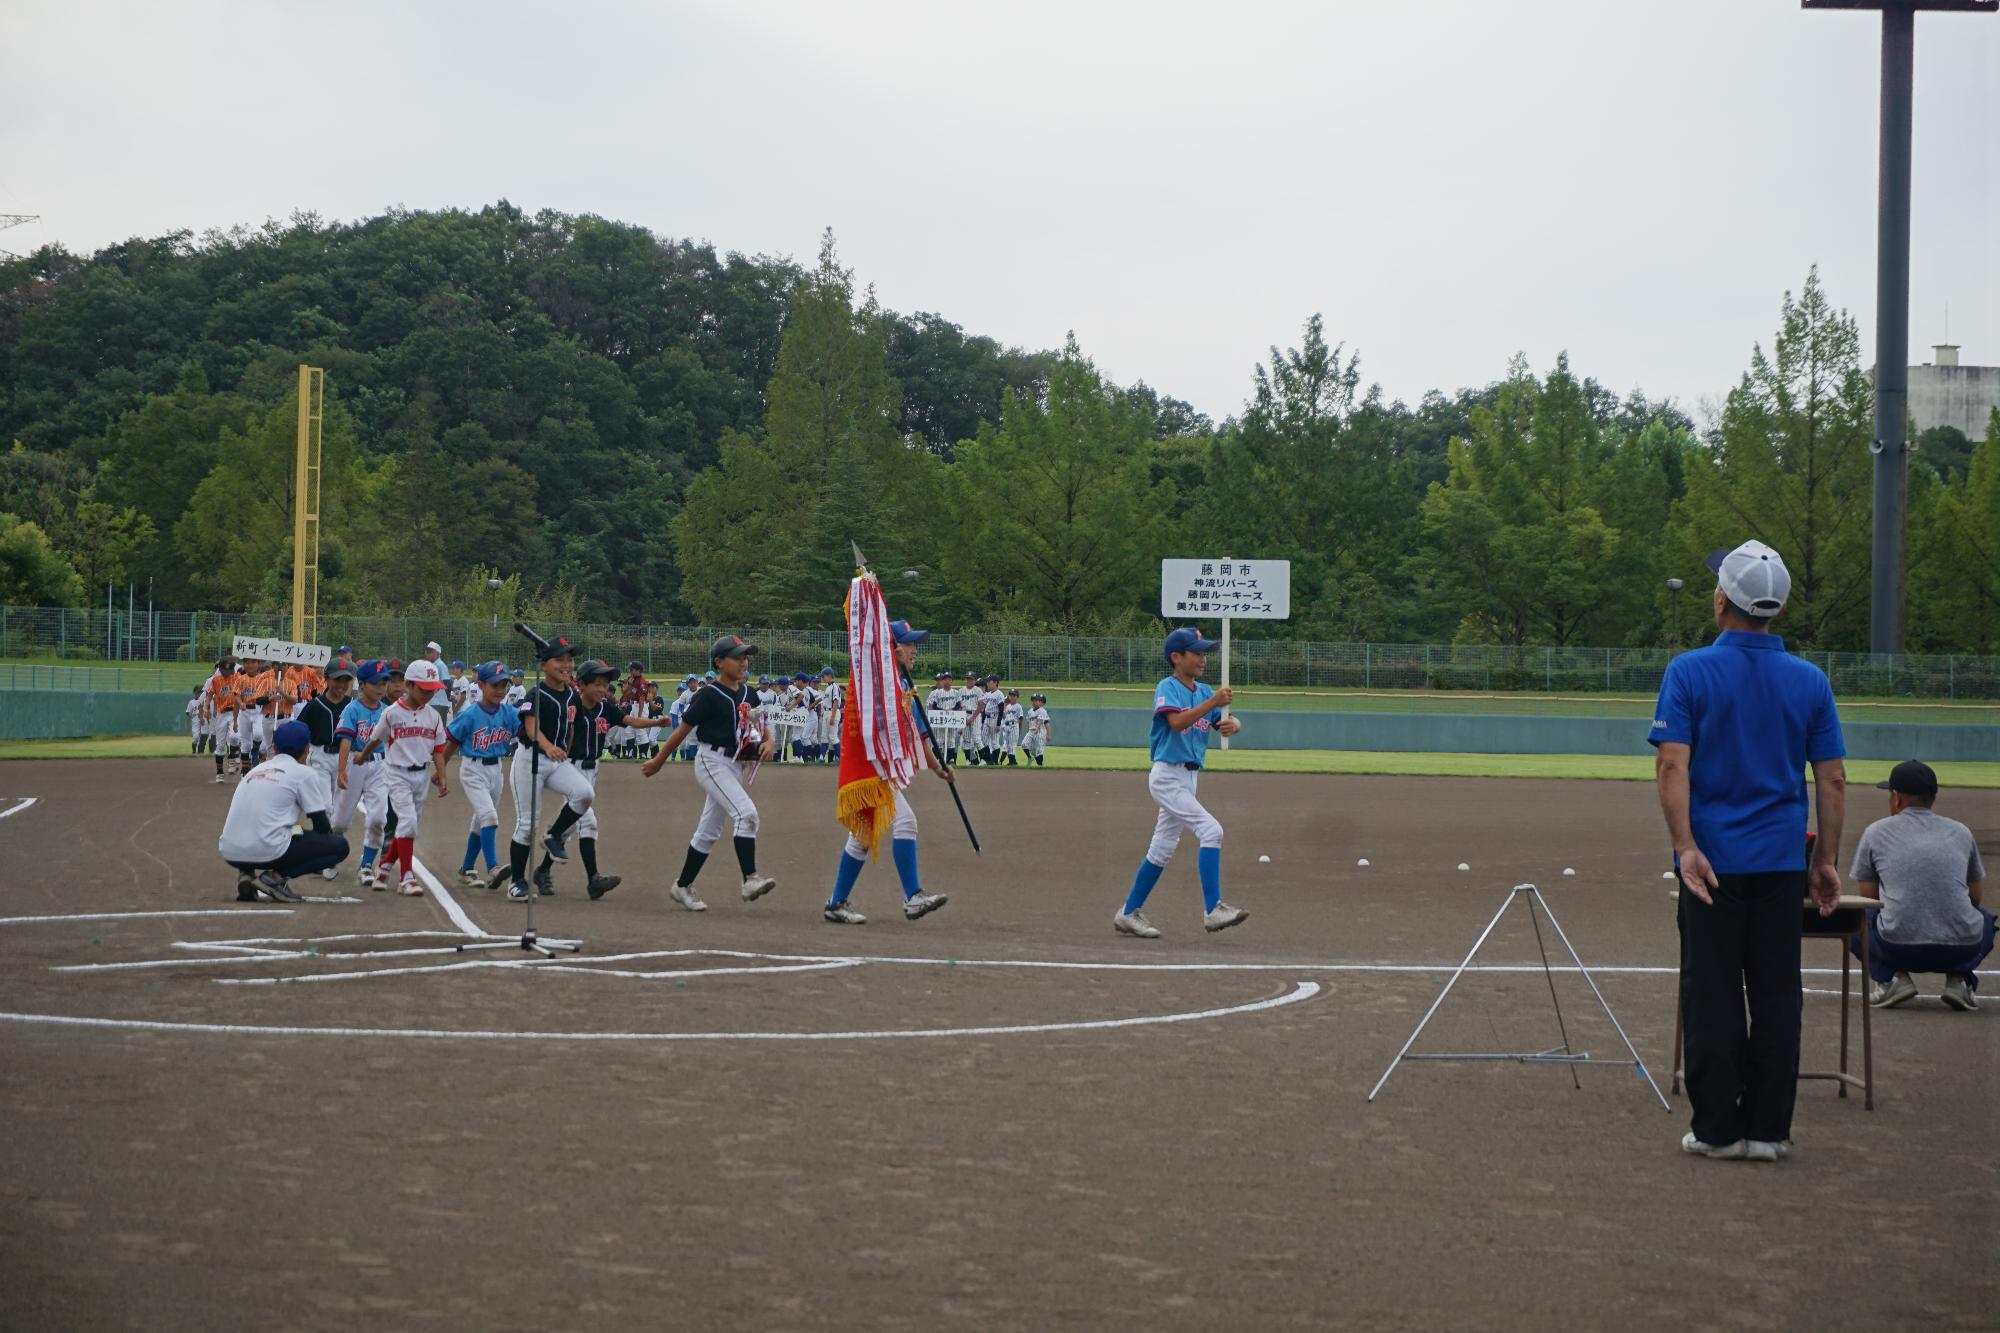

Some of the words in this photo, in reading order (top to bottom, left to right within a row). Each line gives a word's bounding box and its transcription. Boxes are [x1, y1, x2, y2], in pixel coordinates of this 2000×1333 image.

[1201, 564, 1251, 576] 藤岡市
[1187, 589, 1263, 600] 藤岡ルーキーズ
[1176, 602, 1273, 613] 美九里ファイターズ
[236, 639, 325, 662] 新町イーグレット
